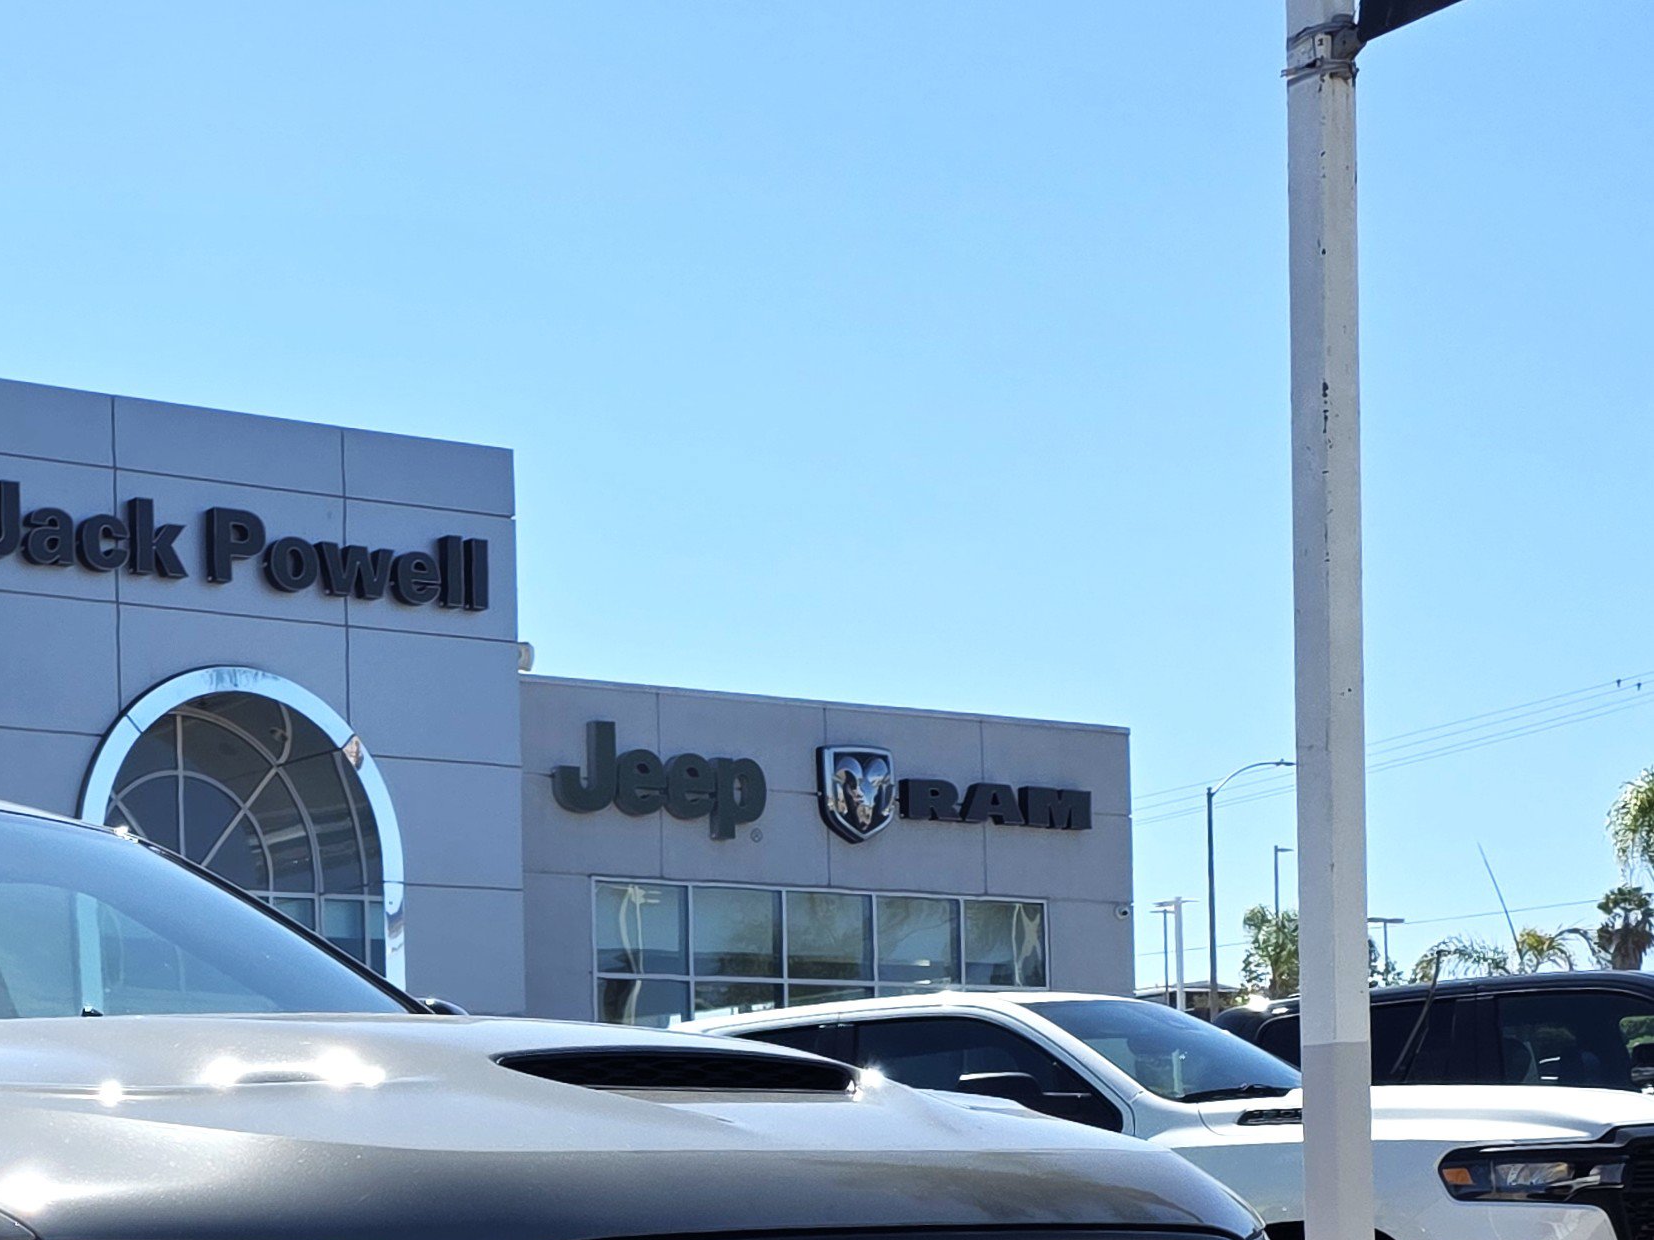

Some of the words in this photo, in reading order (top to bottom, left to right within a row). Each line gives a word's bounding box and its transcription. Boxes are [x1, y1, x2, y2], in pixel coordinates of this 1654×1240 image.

[204, 506, 490, 611] Powell
[551, 720, 767, 840] Jeep
[898, 778, 1092, 830] RAM
